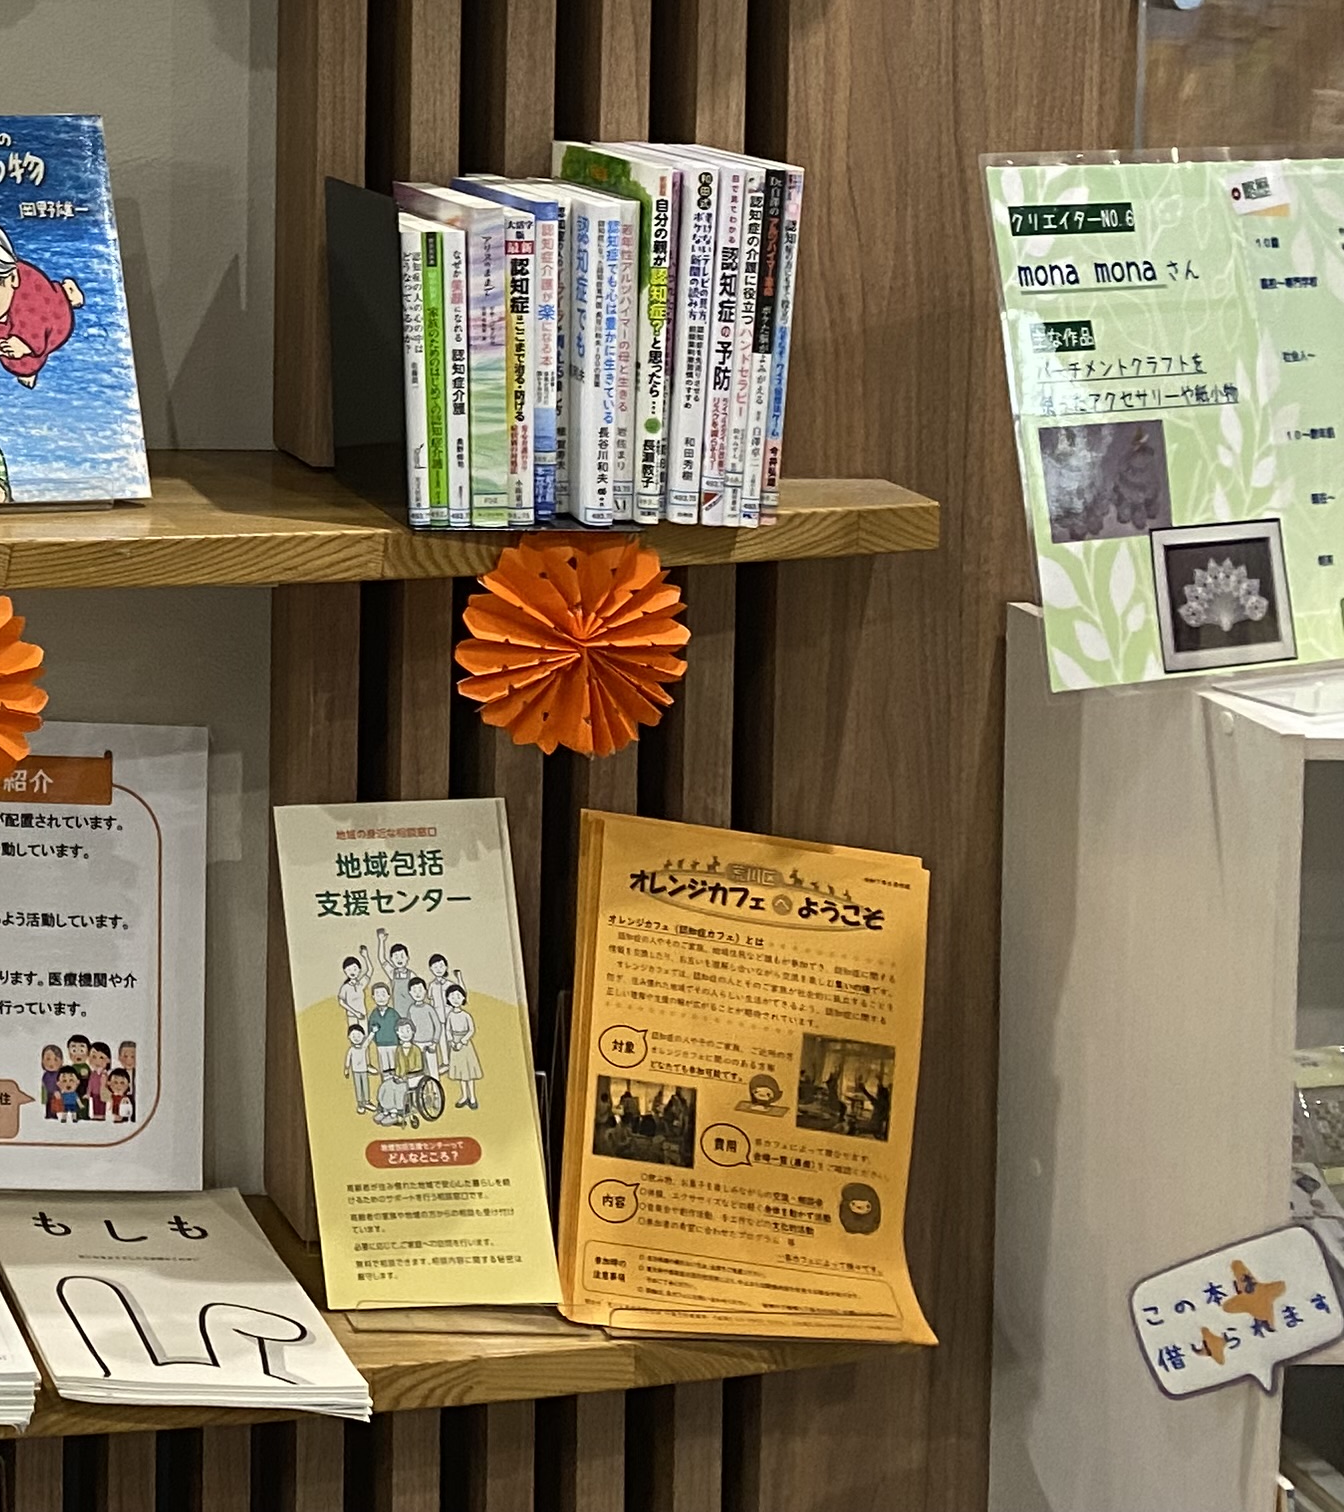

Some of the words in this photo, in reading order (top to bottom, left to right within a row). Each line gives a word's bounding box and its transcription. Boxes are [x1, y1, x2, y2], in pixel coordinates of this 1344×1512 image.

[1017, 264, 1080, 287] mona
[1094, 261, 1157, 283] mona
[1167, 260, 1199, 282] さん
[4, 769, 53, 793] 紹介
[335, 849, 444, 879] 地域包括
[316, 888, 472, 917] 支援センター
[630, 869, 766, 912] オレンジカフェ
[797, 901, 886, 931] ようこそ
[612, 1040, 635, 1055] 対象
[602, 1193, 625, 1209] 内容
[32, 1211, 209, 1242] もしも
